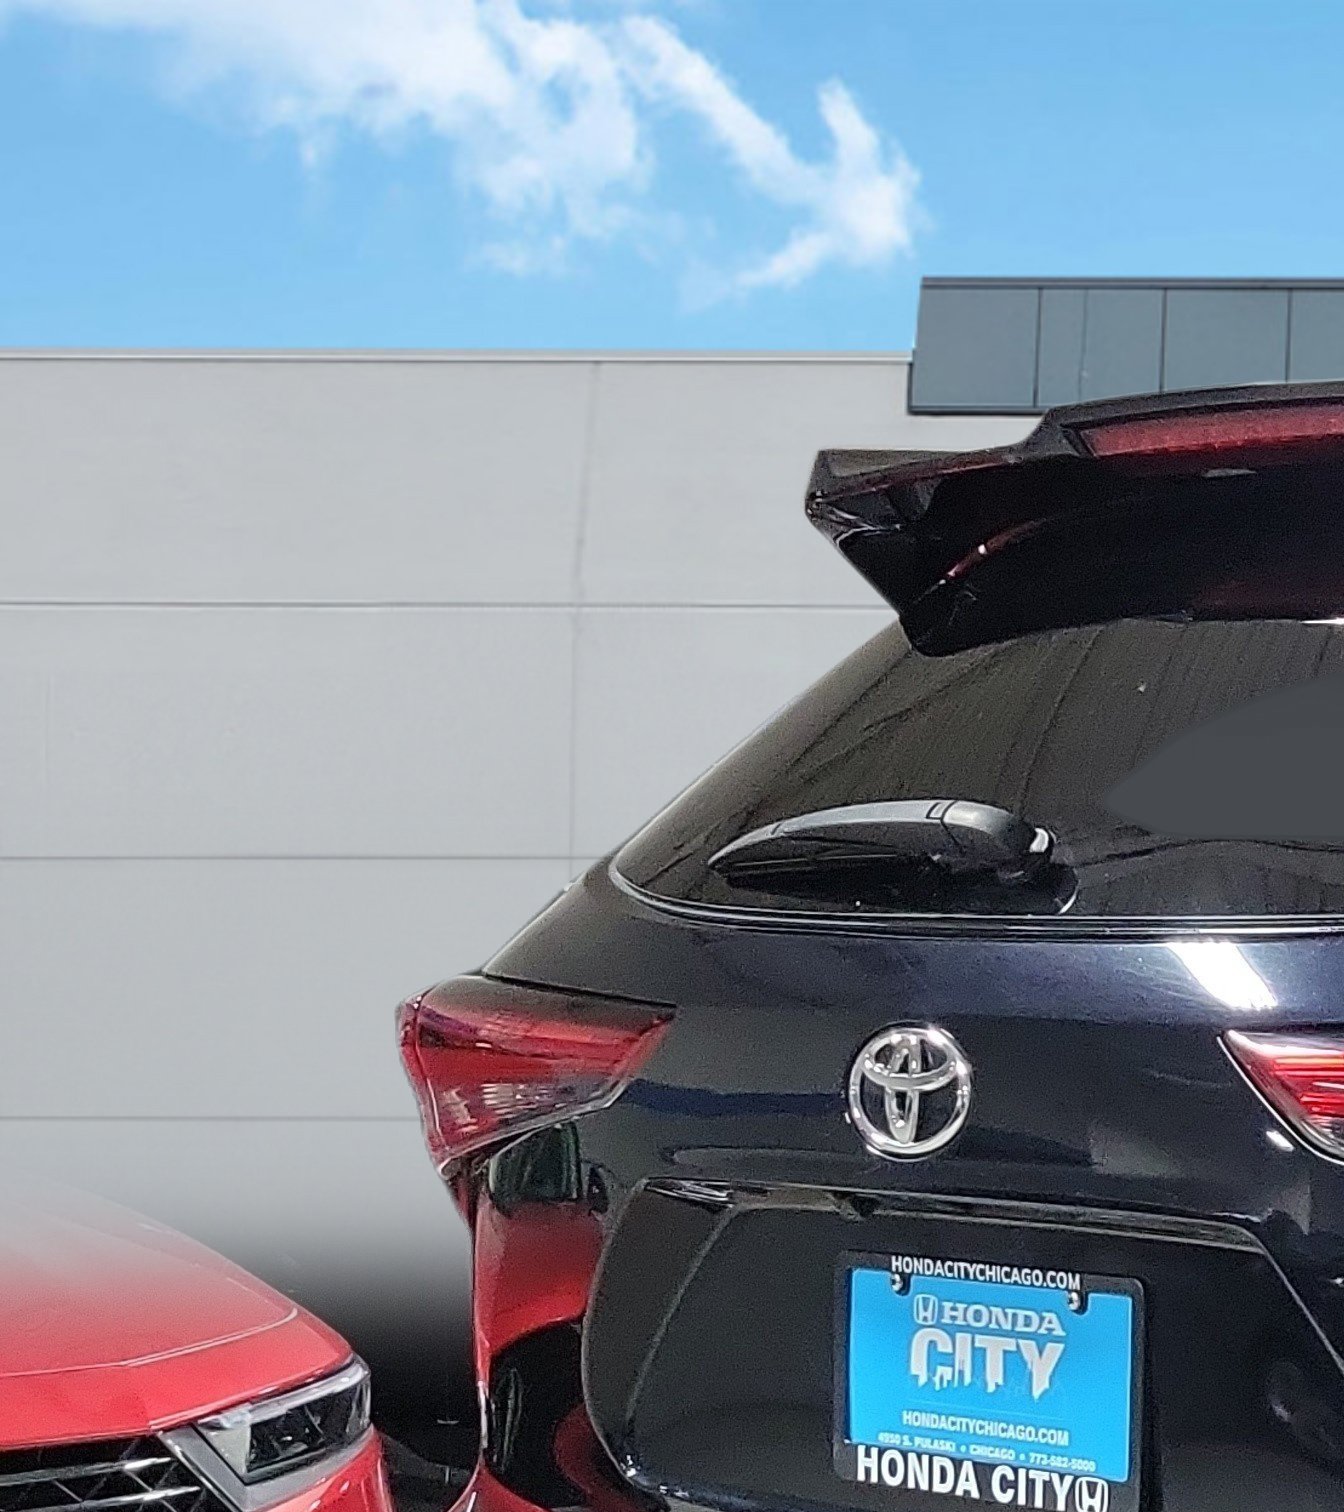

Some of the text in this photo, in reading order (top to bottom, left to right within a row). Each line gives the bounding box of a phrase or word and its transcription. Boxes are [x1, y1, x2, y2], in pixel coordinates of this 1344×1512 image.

[891, 1256, 1081, 1291] HONDACITYCHICAGO.COM
[940, 1301, 1067, 1336] HONDA
[910, 1327, 1066, 1400] CITY
[902, 1410, 1070, 1447] HONDACITYCHICAGO.COM
[913, 1436, 957, 1452] PULASKI
[969, 1445, 1016, 1461] CHICAGO
[857, 1445, 1075, 1512] HONDA CITY
